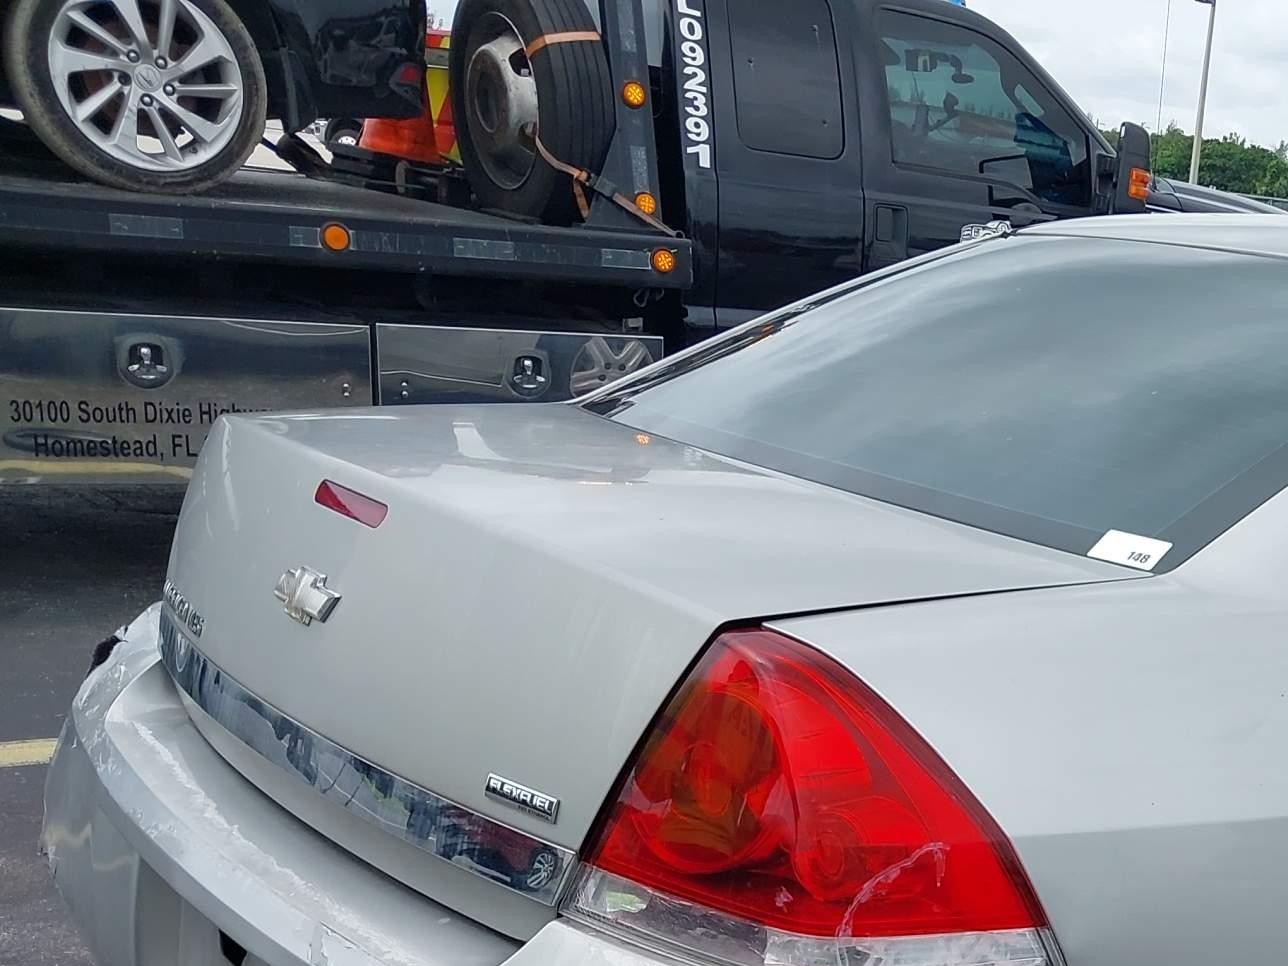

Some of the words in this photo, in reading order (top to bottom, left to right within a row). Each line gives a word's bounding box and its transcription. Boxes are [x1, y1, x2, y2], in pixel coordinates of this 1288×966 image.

[10, 400, 70, 423] 30100
[78, 400, 136, 424] South
[144, 401, 193, 424] Dixie
[34, 433, 164, 461] Homestead,
[173, 434, 199, 458] FL
[1127, 551, 1151, 564] 148
